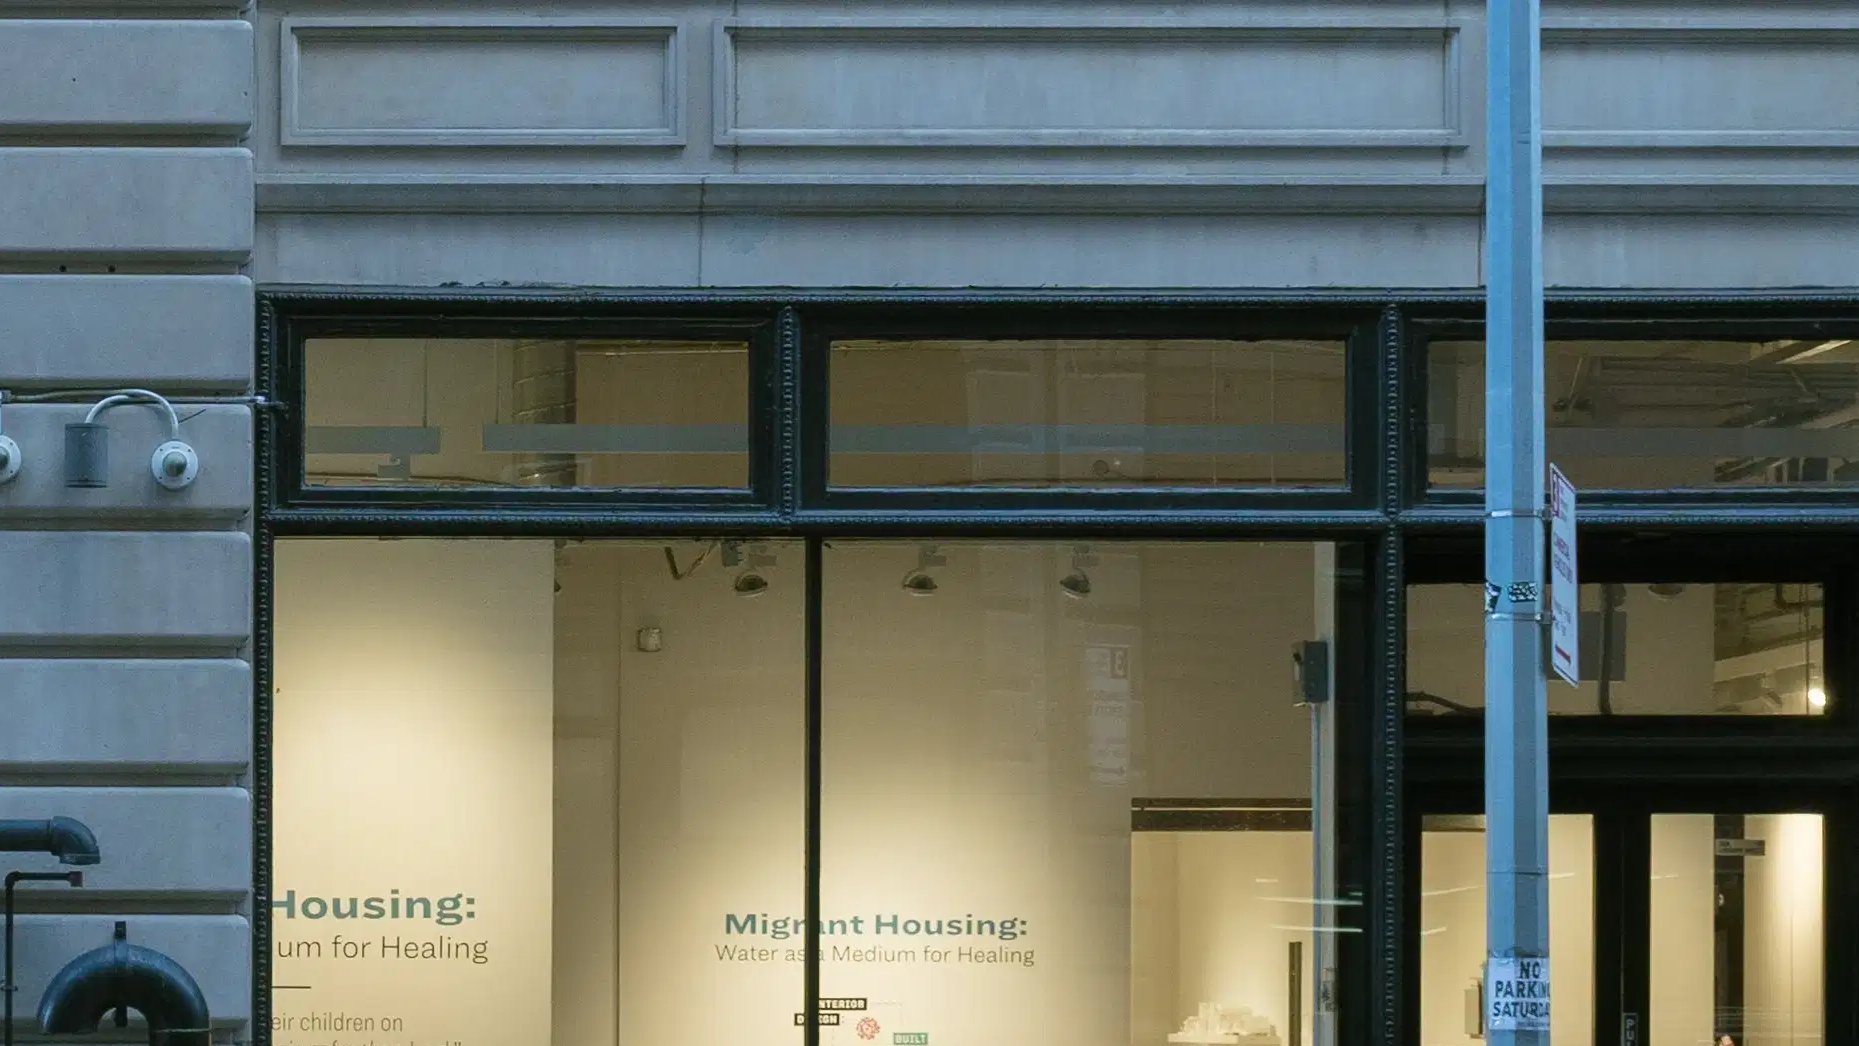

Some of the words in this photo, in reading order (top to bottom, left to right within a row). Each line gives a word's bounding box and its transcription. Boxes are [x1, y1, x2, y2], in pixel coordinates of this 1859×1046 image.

[272, 889, 476, 926] Housing:
[875, 914, 1028, 941] Housing:
[332, 935, 371, 959] for
[382, 936, 489, 964] Healing
[714, 944, 779, 961] Water
[832, 945, 916, 963] Medium
[923, 945, 952, 963] for
[957, 946, 1035, 967] Healing
[1519, 960, 1542, 979] NO
[818, 999, 865, 1009] NTERIOR
[300, 1011, 374, 1031] children
[380, 1016, 403, 1031] on
[895, 1034, 928, 1045] BUILT
